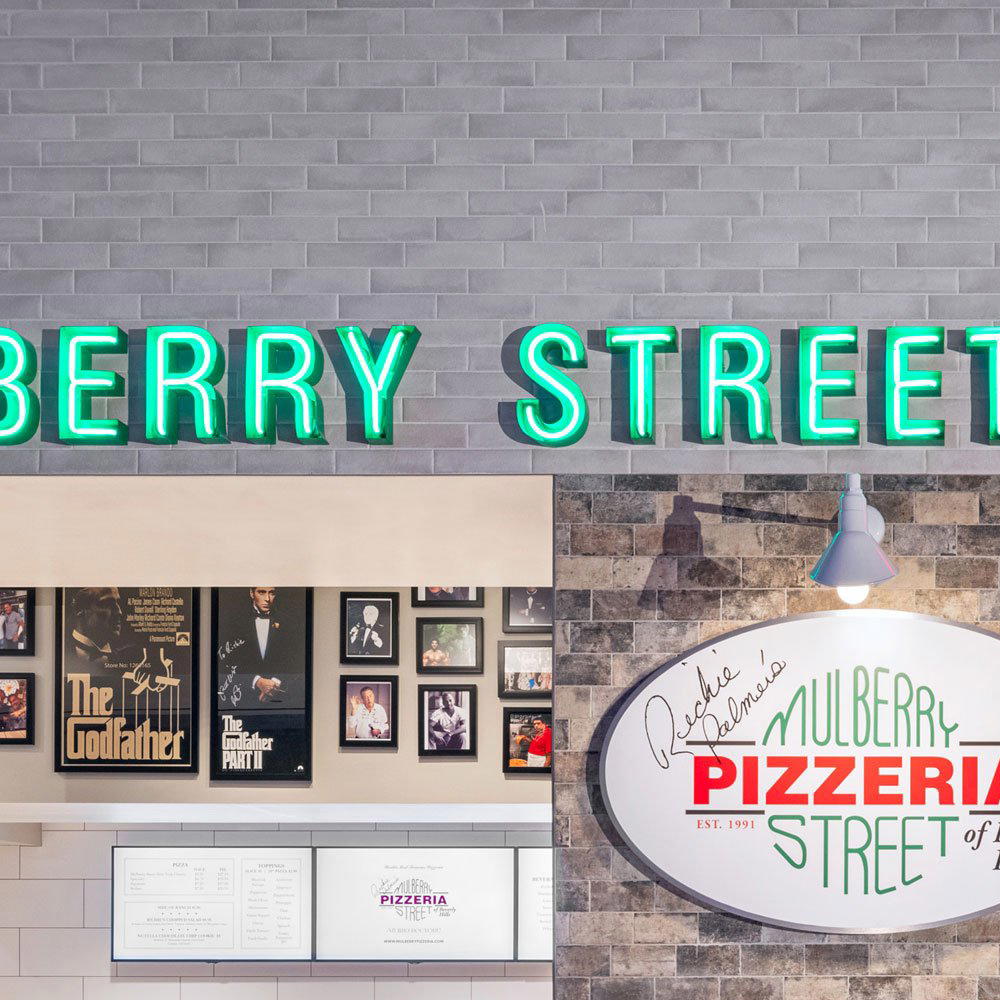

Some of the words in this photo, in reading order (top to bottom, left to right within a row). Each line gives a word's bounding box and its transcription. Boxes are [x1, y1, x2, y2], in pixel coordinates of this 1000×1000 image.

[67, 673, 113, 716] The
[644, 649, 741, 770] Richie
[762, 665, 959, 748] MULBERRY
[222, 715, 243, 731] The
[66, 716, 185, 760] Godfather
[222, 731, 273, 751] Godfather
[222, 750, 253, 770] PART
[254, 750, 263, 770] II
[696, 819, 723, 829] EST.
[728, 819, 756, 829] 1991
[964, 821, 991, 850] of
[768, 815, 959, 895] STREET
[394, 878, 433, 895] MULBERRY
[380, 895, 447, 905] PIZZERIA
[394, 905, 433, 922] STREET
